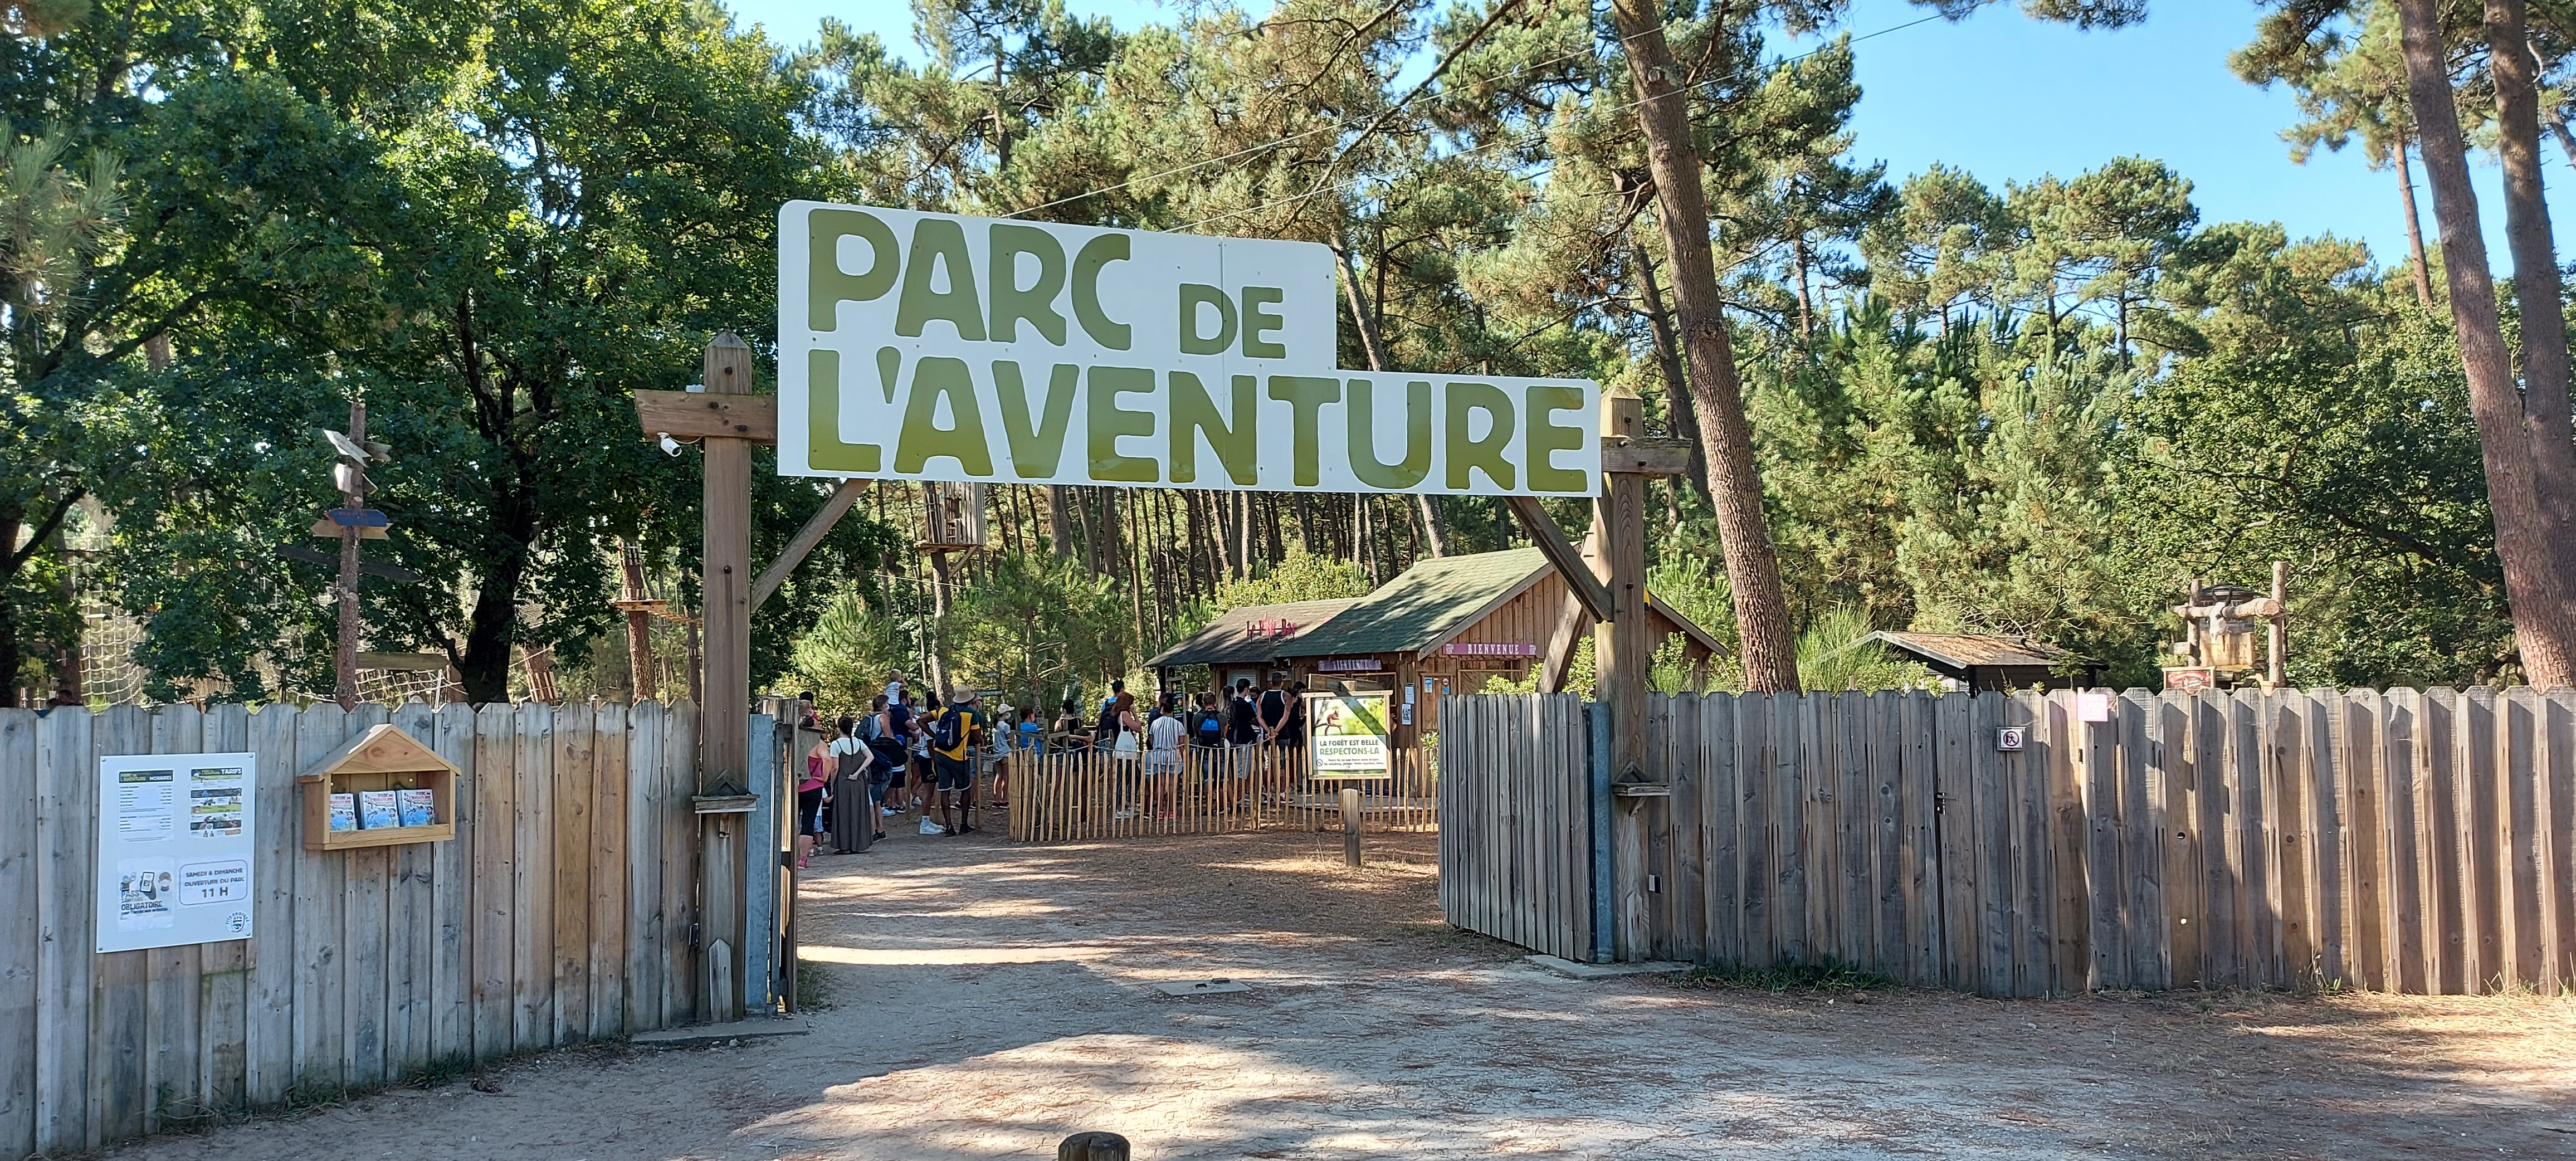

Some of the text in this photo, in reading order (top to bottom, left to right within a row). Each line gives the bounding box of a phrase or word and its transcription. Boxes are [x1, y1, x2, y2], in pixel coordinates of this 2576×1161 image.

[808, 208, 1286, 359] PARC DE
[808, 347, 1588, 492] L'AVENTURE
[1281, 618, 1297, 636] Bar
[1468, 643, 1519, 655] BIENVENUE
[1320, 747, 1379, 755] RESPECTONS-LA
[202, 886, 228, 898] 11 H
[121, 901, 163, 910] OBLIGATOIRE
